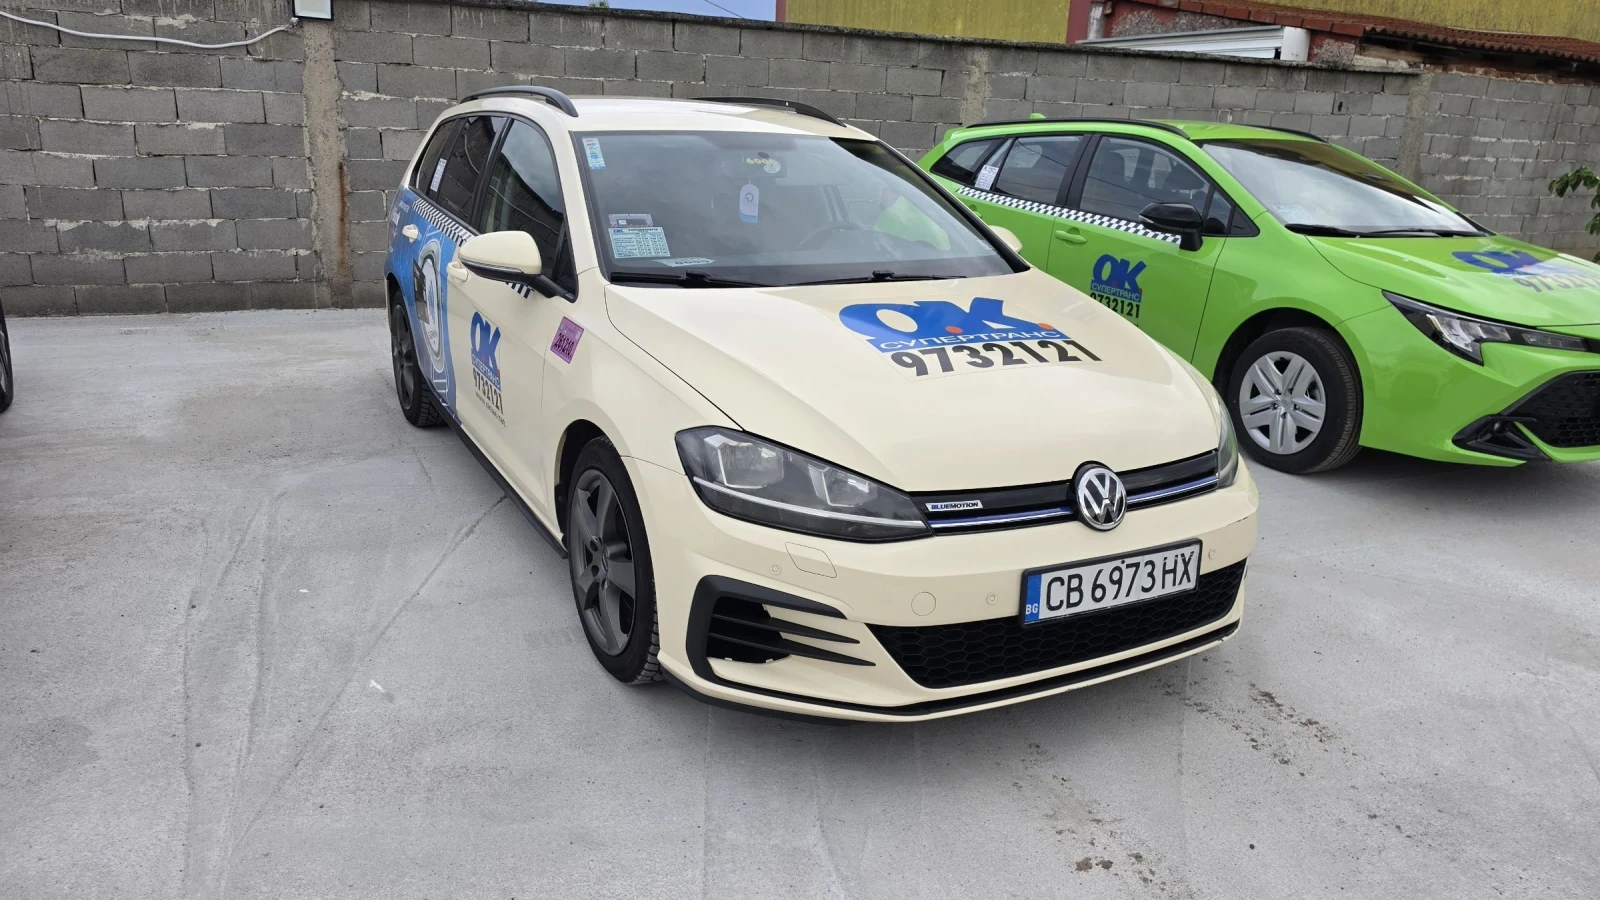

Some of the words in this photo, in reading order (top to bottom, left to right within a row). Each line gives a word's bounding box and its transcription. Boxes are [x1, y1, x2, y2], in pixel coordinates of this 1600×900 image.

[1091, 282, 1140, 301] СУПЕРТРАНС
[879, 331, 1061, 350] СУПЕРТРАНС
[890, 339, 1103, 377] 9732121
[473, 367, 503, 415] 9732121
[931, 502, 979, 510] BLUEMOTION
[1046, 573, 1084, 612] CB
[1091, 559, 1156, 603] 6973
[1162, 550, 1195, 590] HX
[1025, 603, 1039, 615] BG
